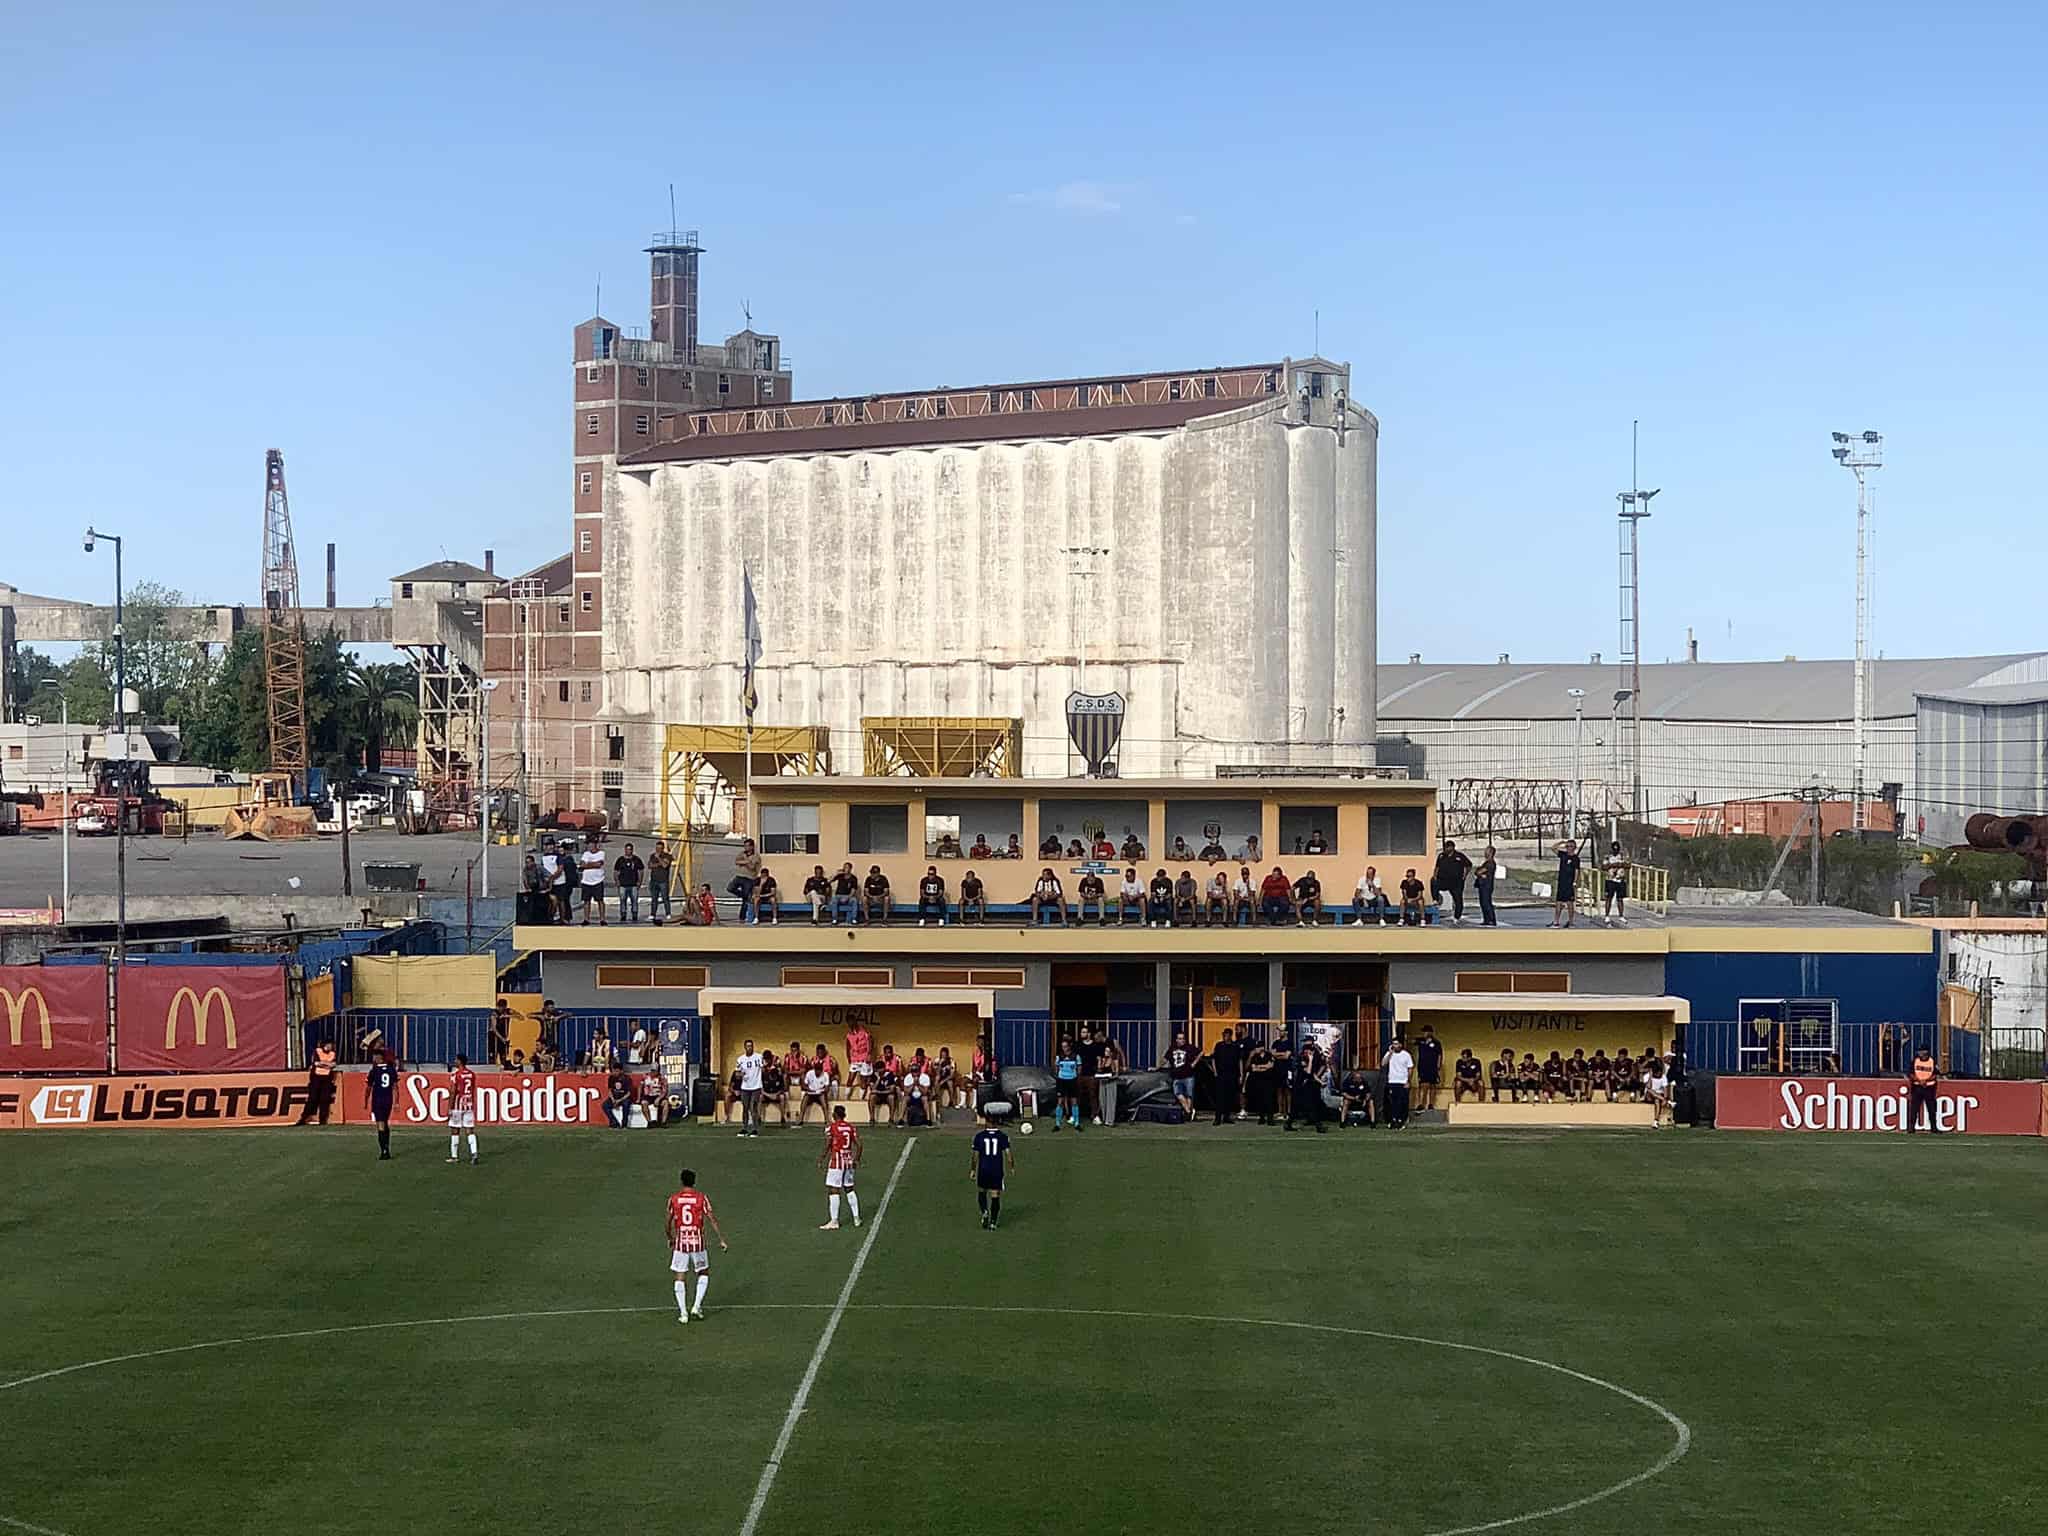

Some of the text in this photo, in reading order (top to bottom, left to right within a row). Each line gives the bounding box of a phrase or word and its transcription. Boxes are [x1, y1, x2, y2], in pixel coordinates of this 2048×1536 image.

[1491, 1014, 1585, 1031] VISITANTE
[381, 1073, 390, 1088] 9
[464, 1079, 472, 1094] 2
[93, 1084, 336, 1122] LÜSQTOF
[406, 1074, 600, 1122] Scneider
[842, 1131, 851, 1149] 3
[983, 1138, 998, 1156] 11
[681, 1204, 693, 1226] 6
